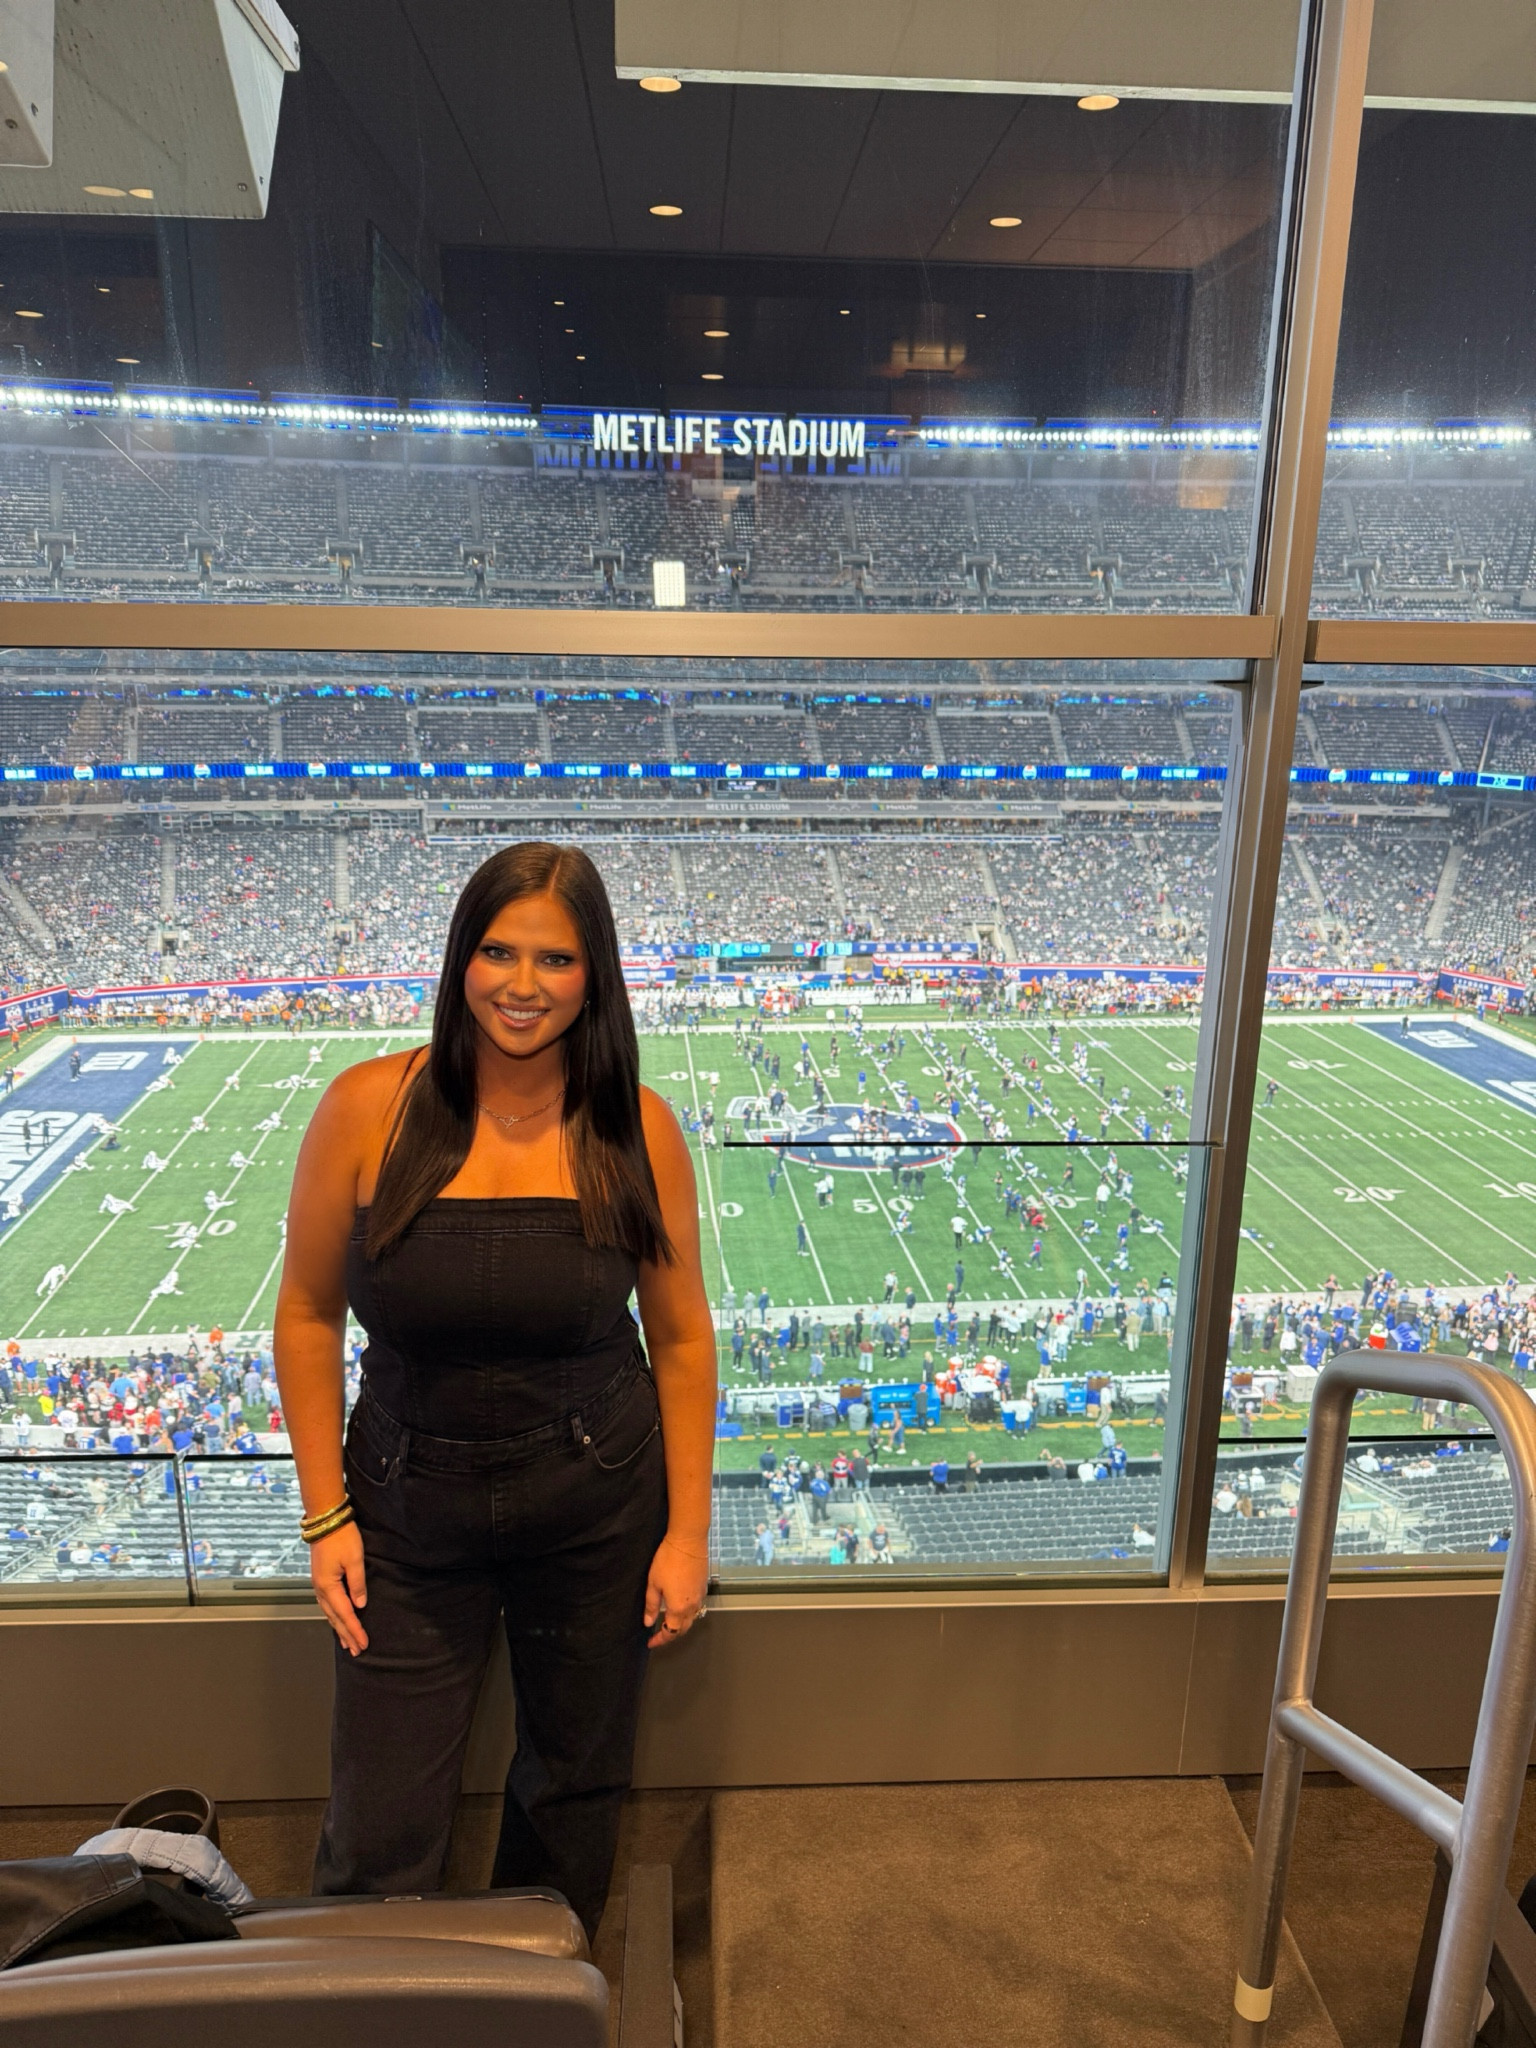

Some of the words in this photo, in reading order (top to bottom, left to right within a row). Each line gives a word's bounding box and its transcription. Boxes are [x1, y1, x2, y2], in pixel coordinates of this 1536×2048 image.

[593, 414, 722, 454] METLIFE
[733, 418, 865, 458] STADIUM
[706, 803, 746, 811] METLIFE
[748, 803, 790, 811] STADIUM
[1333, 1187, 1395, 1202] 20
[852, 1198, 914, 1214] 50
